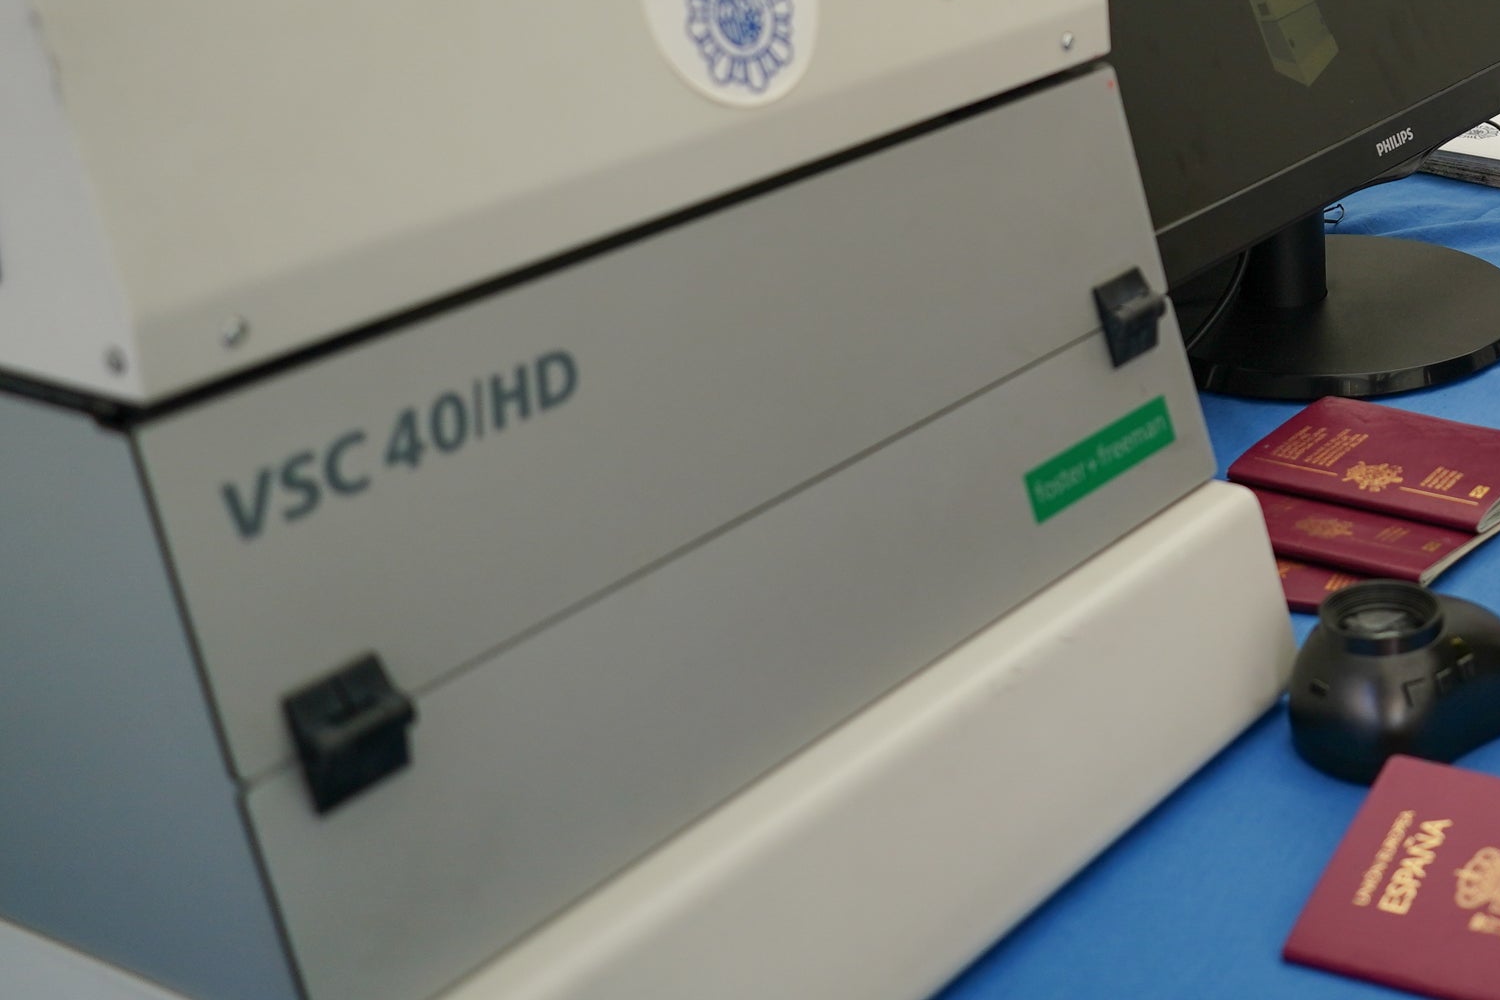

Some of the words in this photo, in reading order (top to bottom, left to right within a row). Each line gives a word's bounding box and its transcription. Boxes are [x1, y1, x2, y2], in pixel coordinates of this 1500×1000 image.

[1375, 127, 1414, 157] PHILIPS
[221, 428, 371, 542] VSC
[1376, 818, 1454, 915] ESPAÑA
